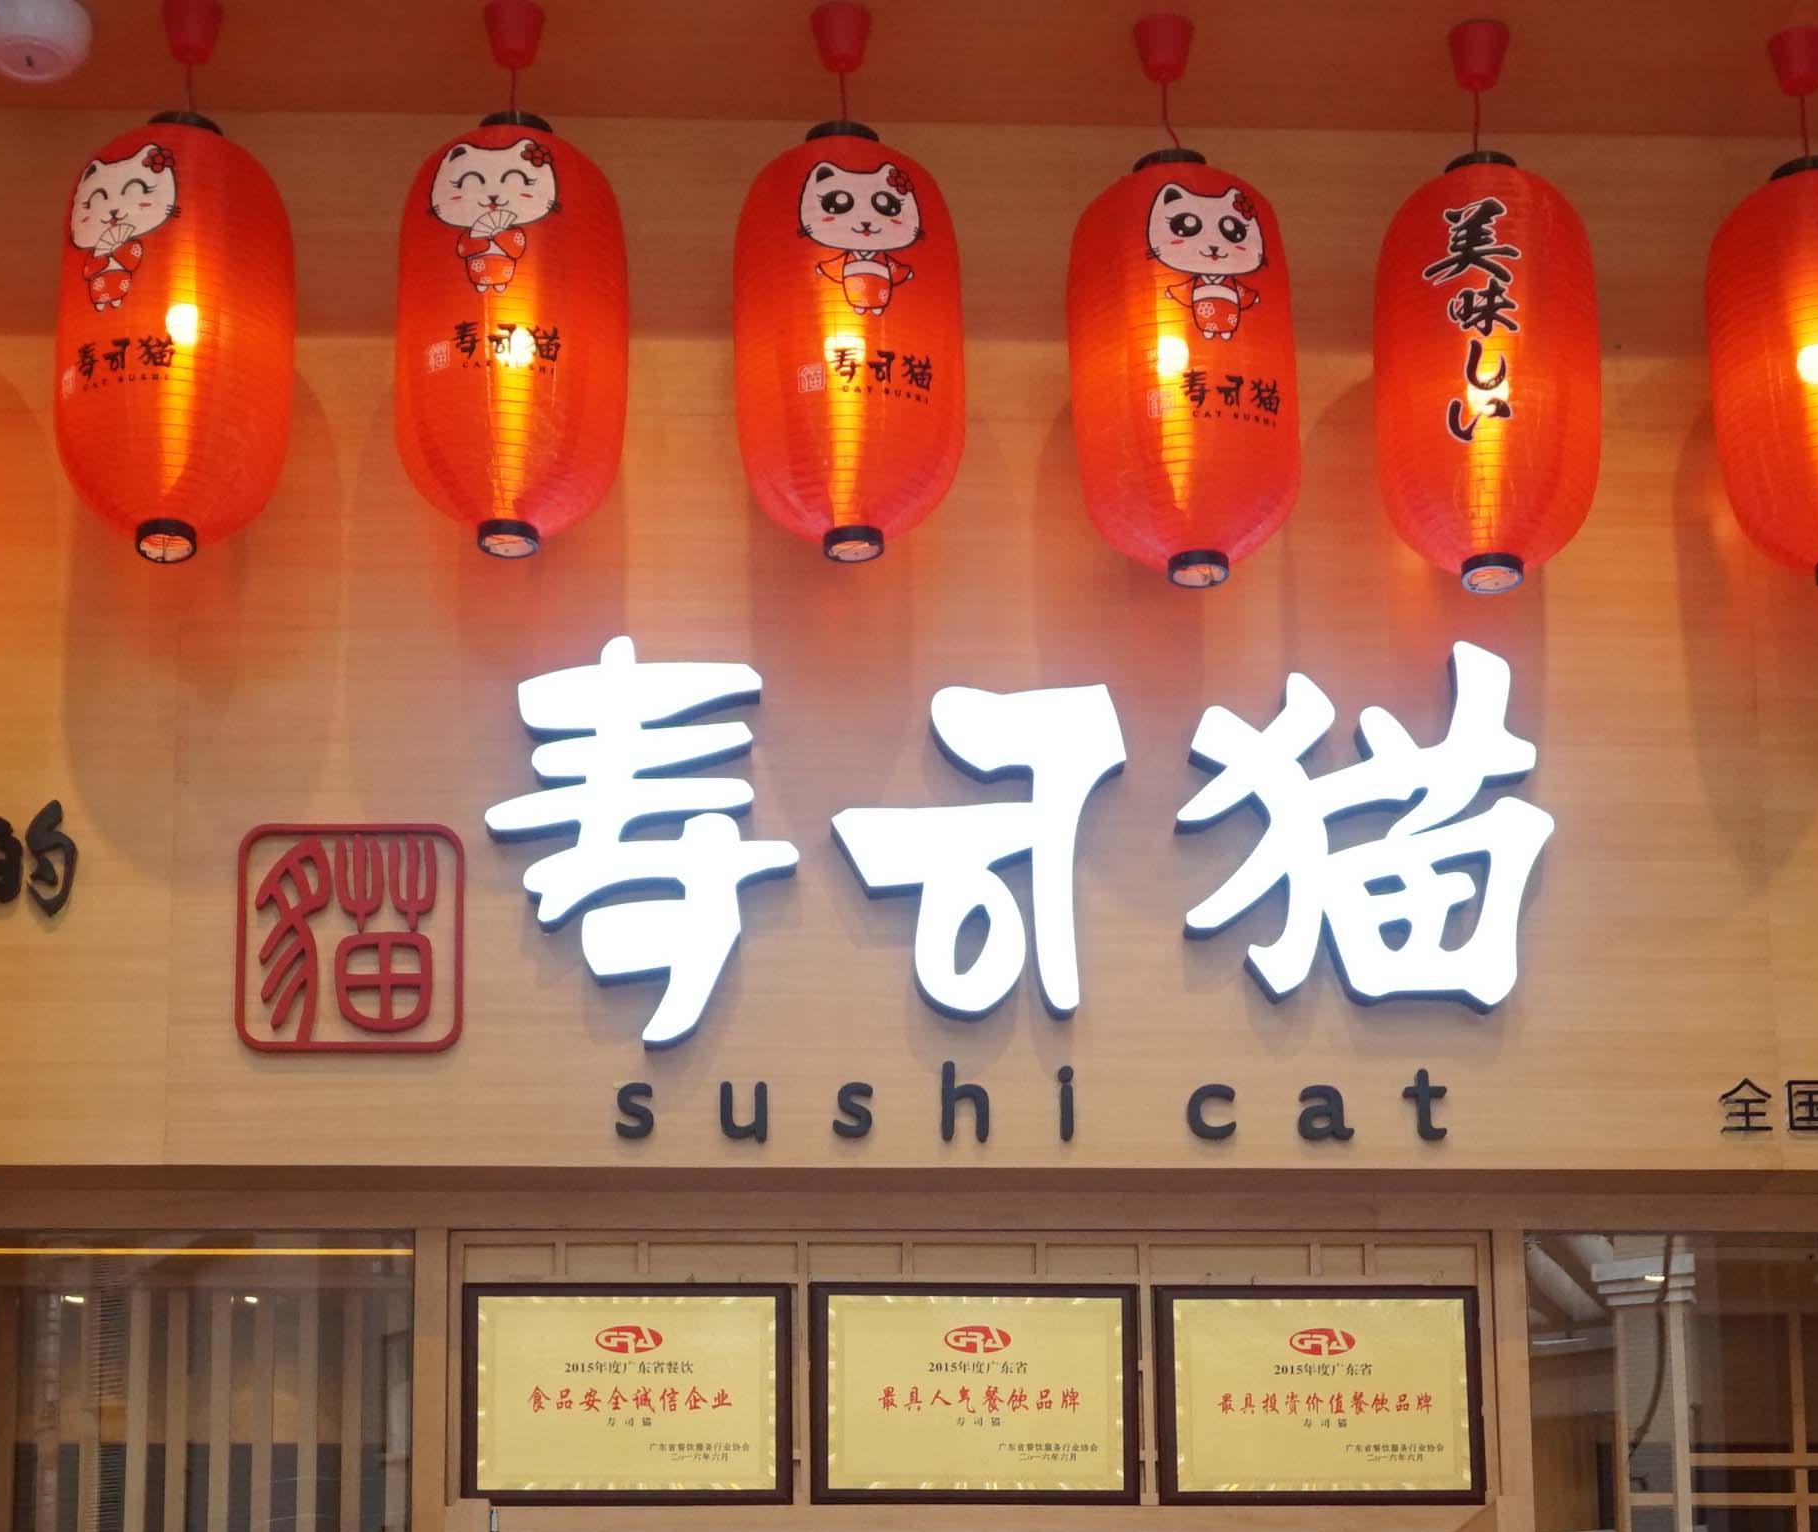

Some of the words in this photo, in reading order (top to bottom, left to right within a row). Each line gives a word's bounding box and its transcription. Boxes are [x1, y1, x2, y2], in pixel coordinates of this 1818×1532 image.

[454, 320, 560, 363] 寿司猫
[1423, 198, 1521, 442] 美味しい
[77, 336, 175, 381] 寿司猫
[830, 348, 933, 392] 寿司猫
[1180, 370, 1281, 416] 寿司猫
[484, 636, 1555, 1049] 寿司猫
[615, 1061, 1076, 1144] sushi
[1186, 1069, 1447, 1142] cat
[564, 1360, 694, 1375] 2015年度广东省餐饮
[928, 1360, 1029, 1375] 2015年度广东省
[1273, 1362, 1374, 1377] 2015年度广东省
[528, 1385, 733, 1413] 食品安全诚信企业
[878, 1385, 1080, 1413] 最具人气餐饮品牌
[1218, 1391, 1433, 1415] 最具投资价值餐饮品牌
